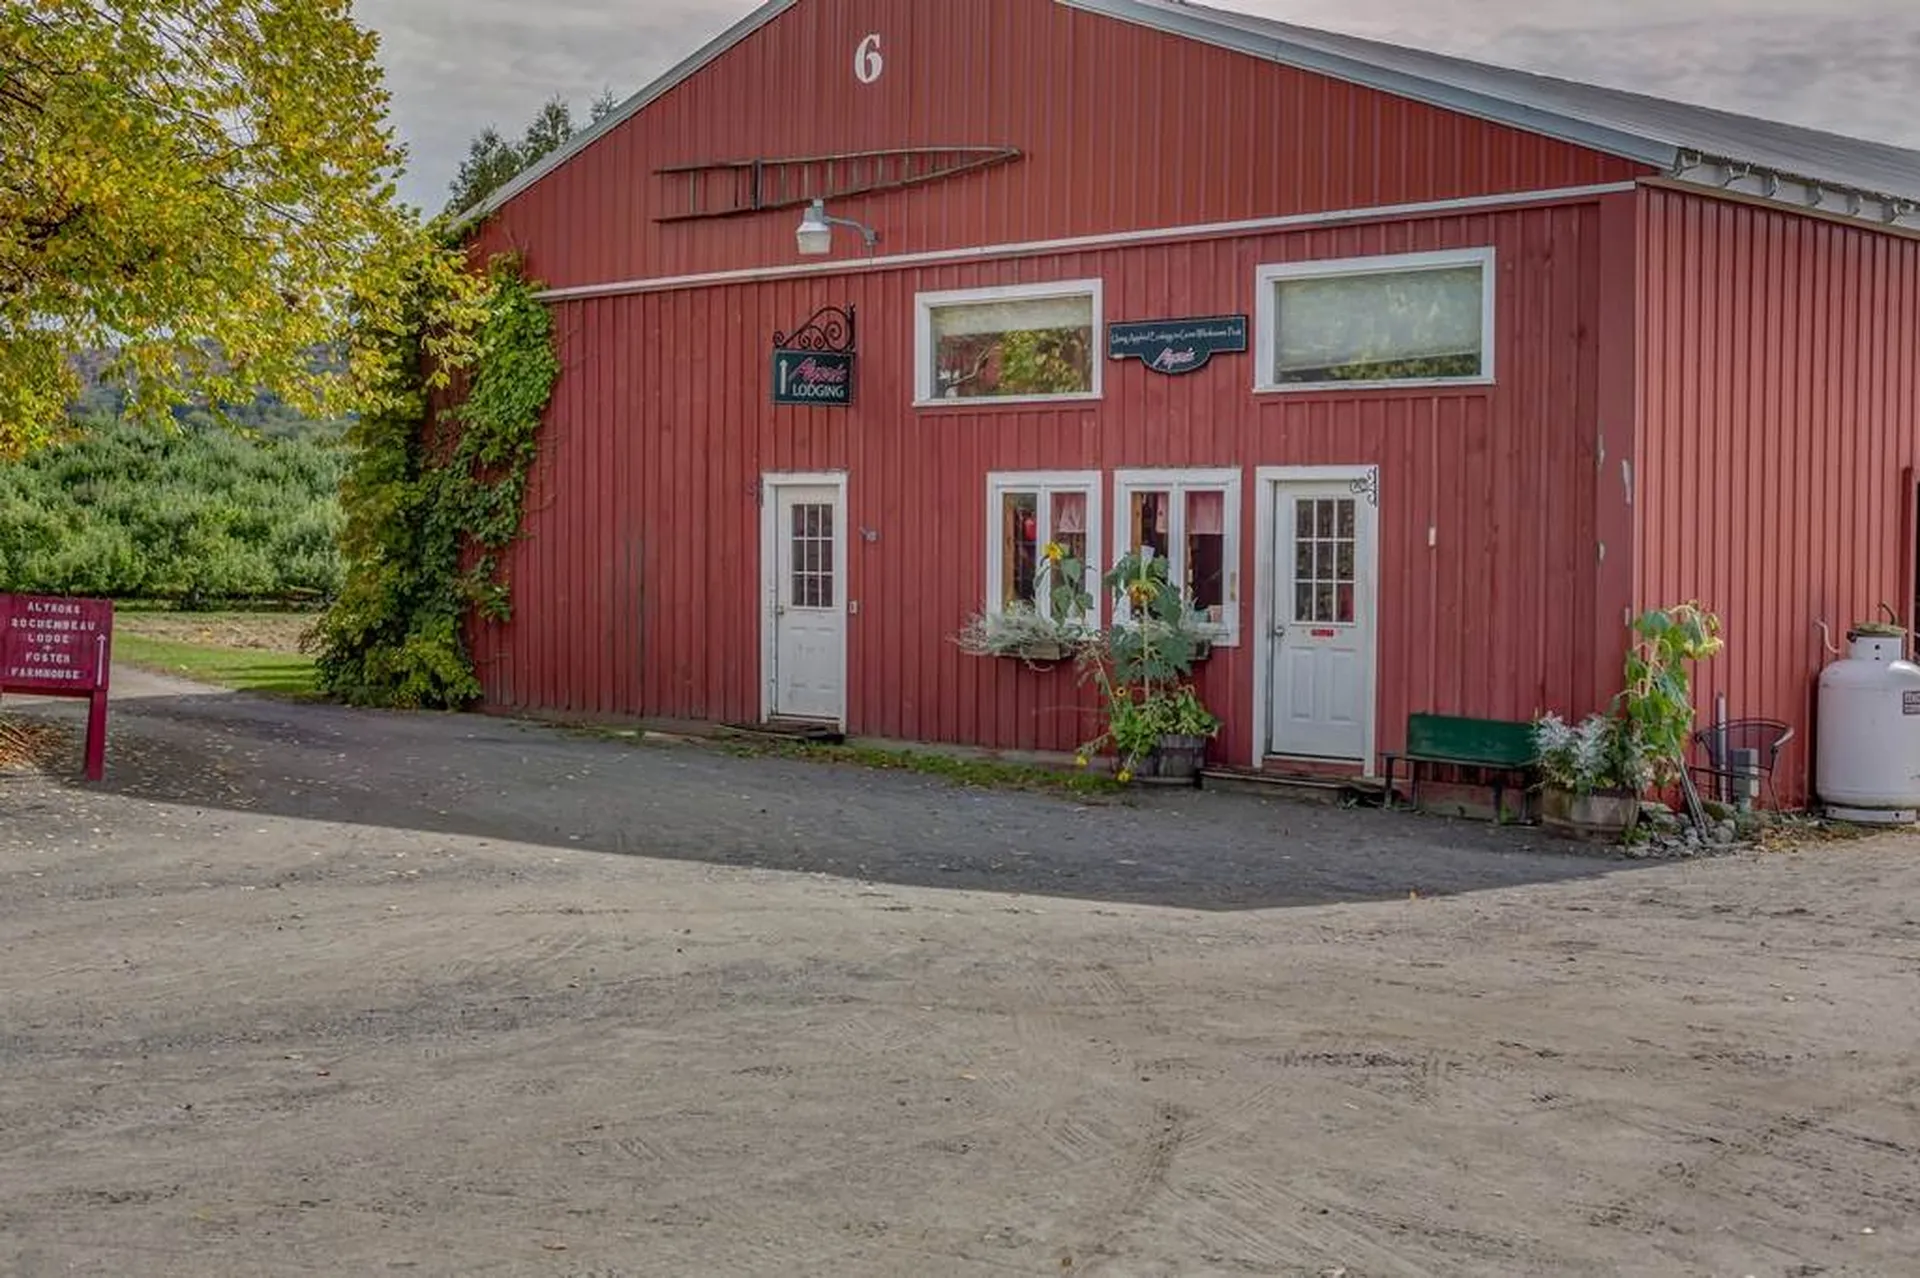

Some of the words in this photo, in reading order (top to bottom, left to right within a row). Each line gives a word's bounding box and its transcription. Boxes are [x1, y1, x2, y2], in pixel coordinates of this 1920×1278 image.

[855, 33, 883, 84] 6
[792, 382, 845, 398] LODGING
[27, 633, 71, 644] LODGE
[25, 651, 71, 663] FOSTER
[11, 667, 81, 680] FARMHOUSE
